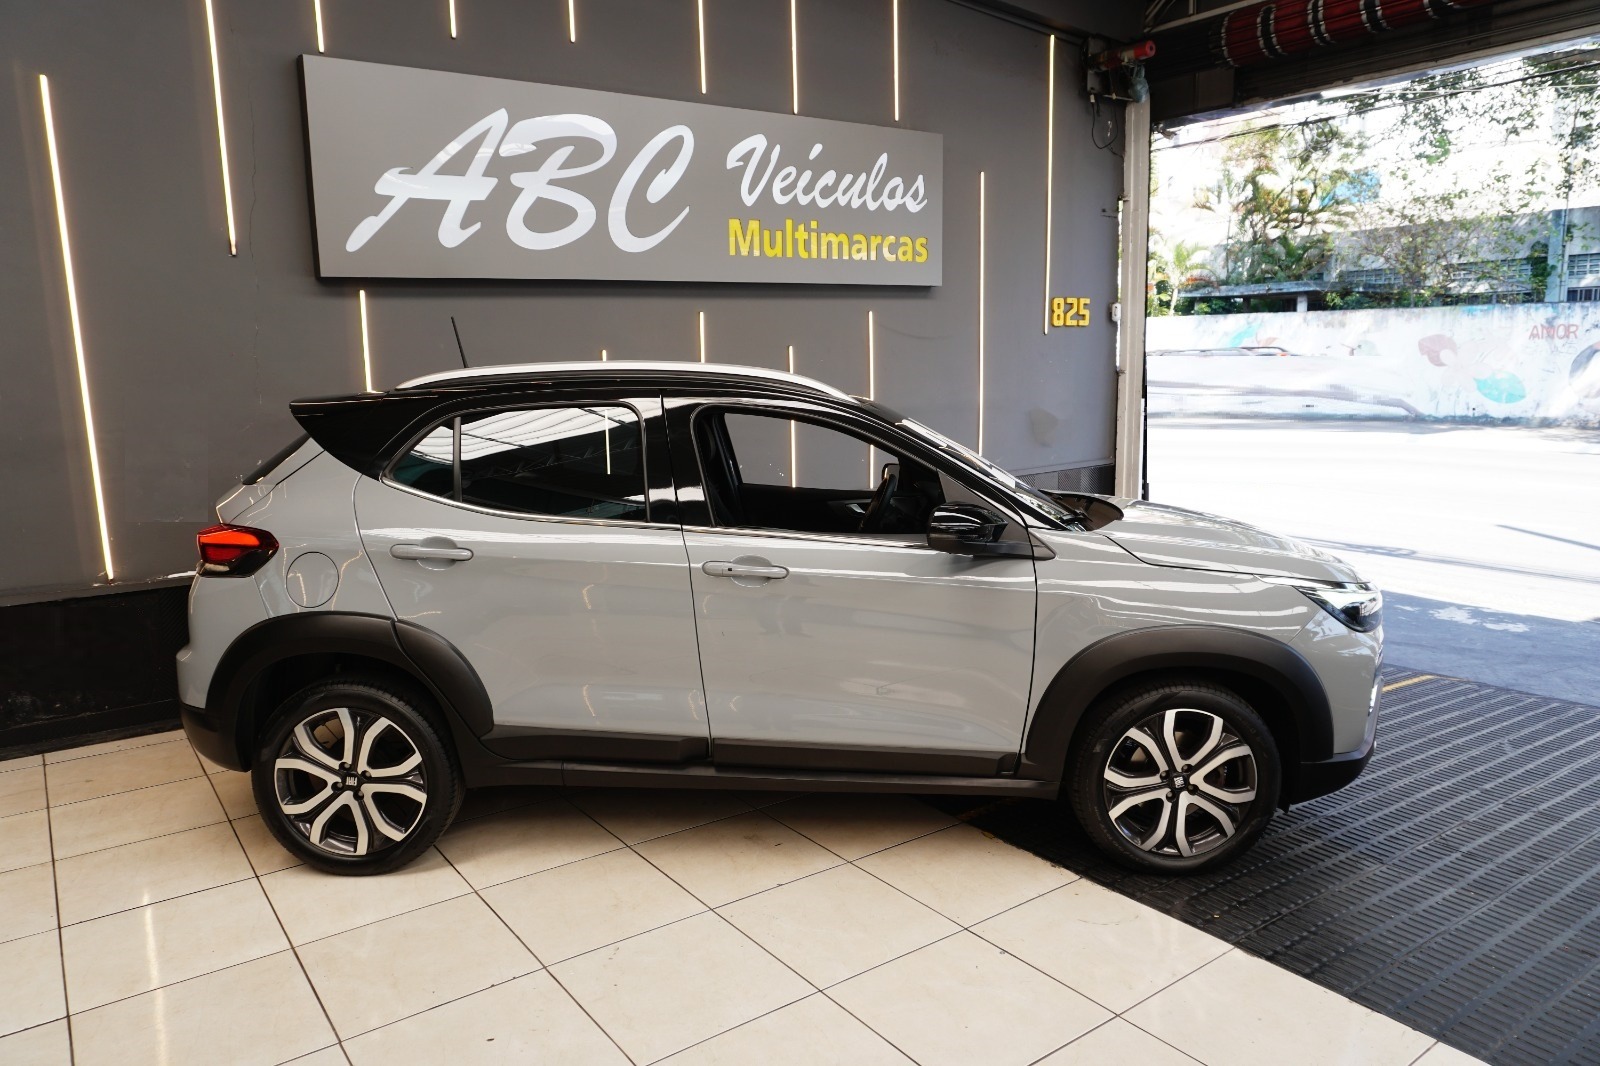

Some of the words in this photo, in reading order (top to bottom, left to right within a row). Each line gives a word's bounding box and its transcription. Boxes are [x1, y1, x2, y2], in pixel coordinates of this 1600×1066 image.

[346, 107, 695, 253] ABC
[726, 133, 928, 213] Veículos
[727, 217, 929, 264] Multimarcas
[1051, 297, 1091, 327] 825
[1529, 323, 1579, 340] AMOR
